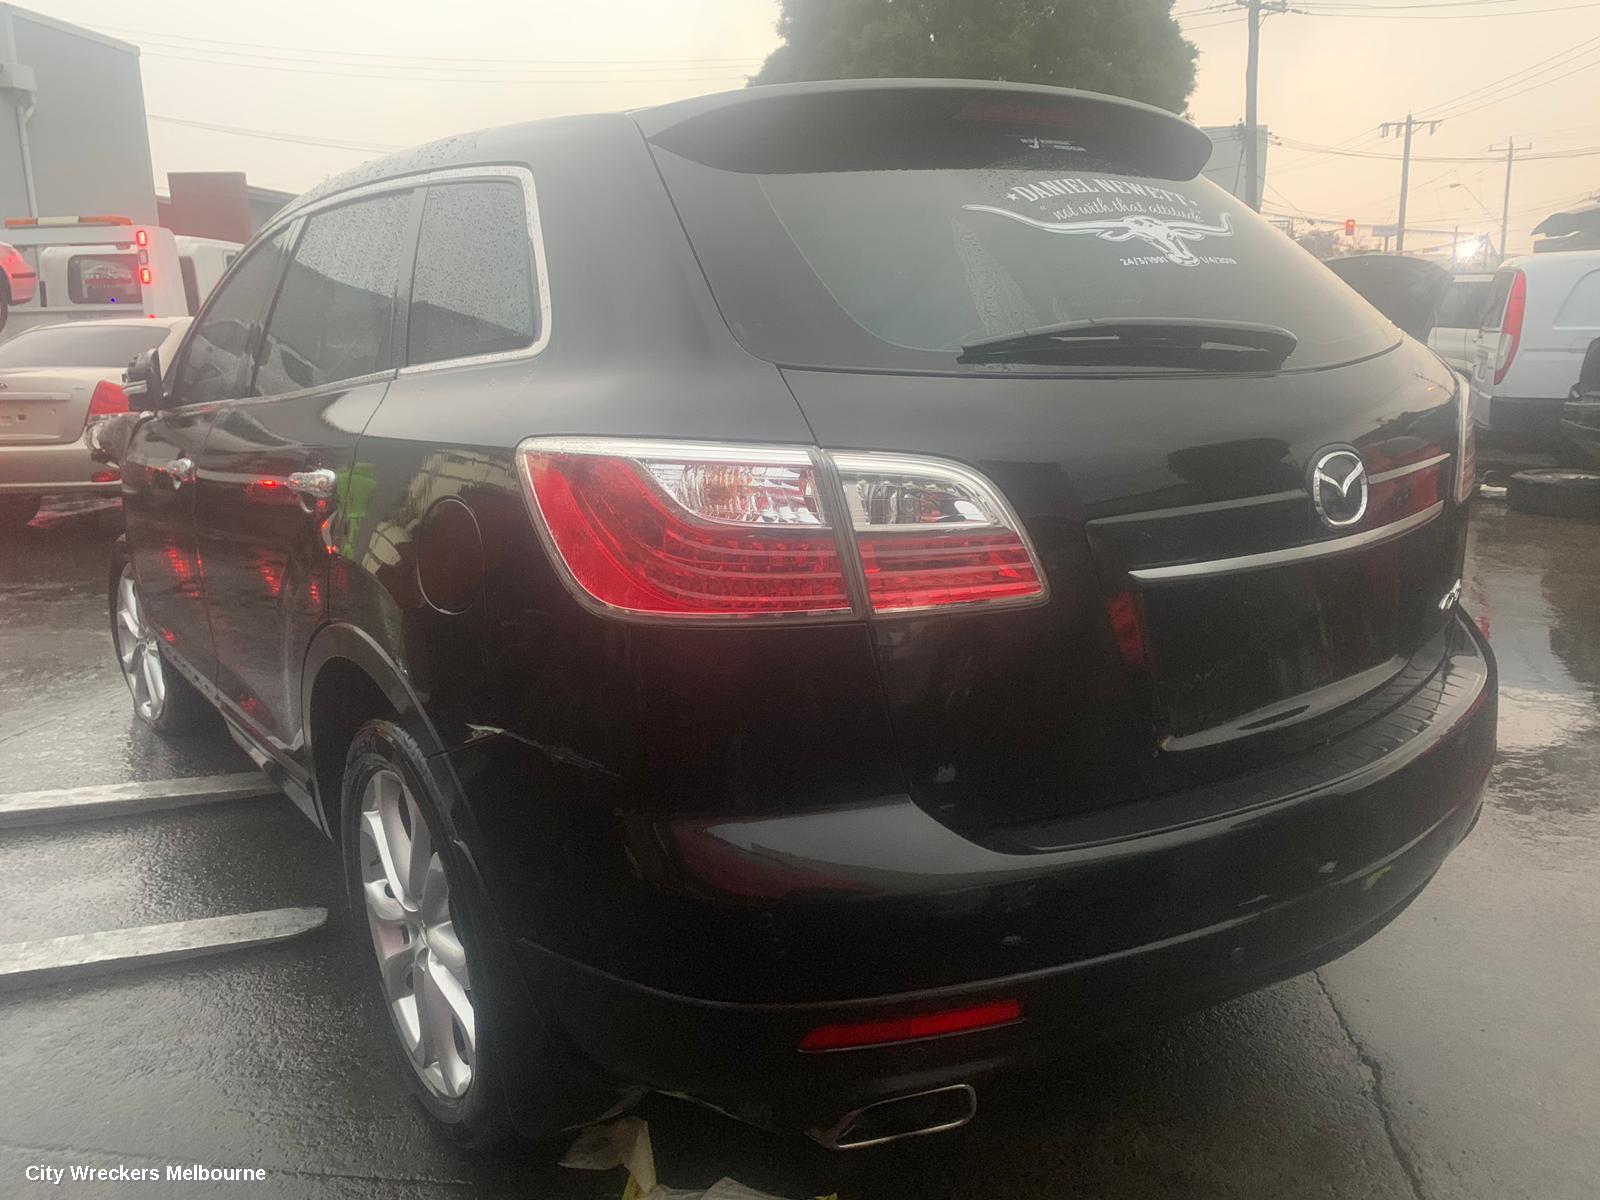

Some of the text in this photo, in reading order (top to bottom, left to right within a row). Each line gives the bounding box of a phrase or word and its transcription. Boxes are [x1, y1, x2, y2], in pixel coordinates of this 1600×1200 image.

[1011, 178, 1188, 206] DANIEL NEWETT
[1079, 196, 1113, 215] with
[1111, 196, 1148, 214] that
